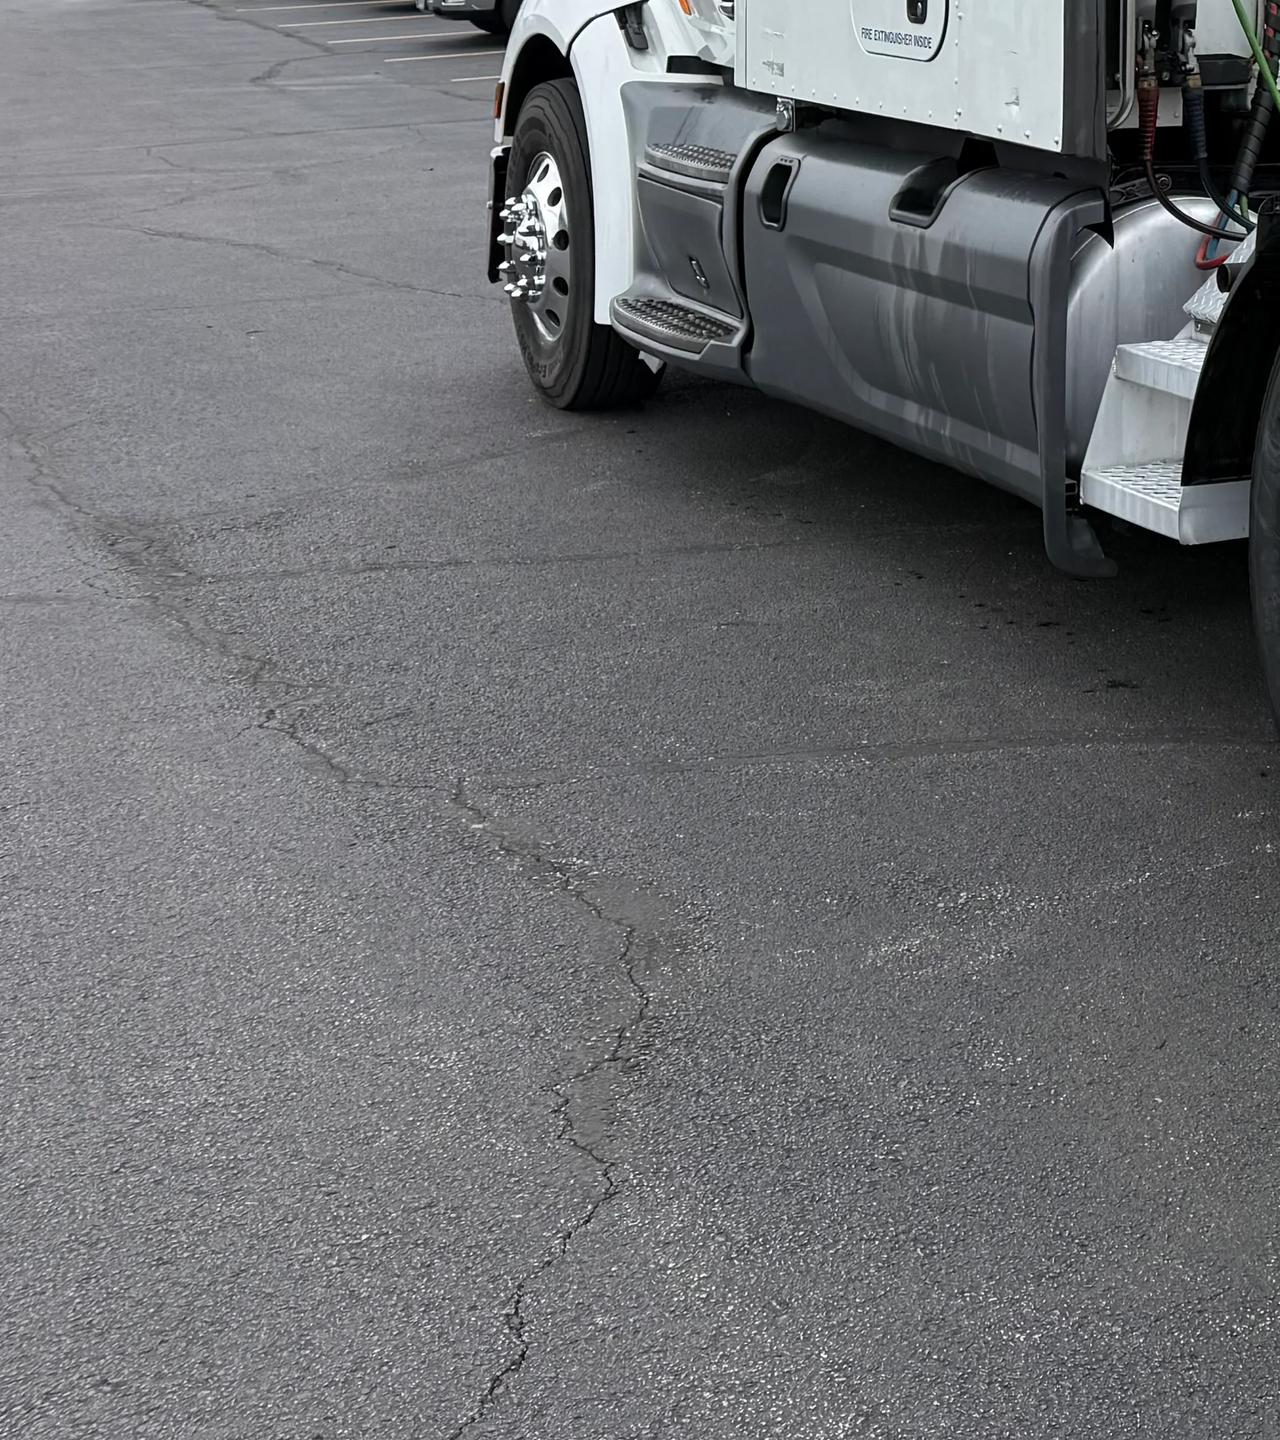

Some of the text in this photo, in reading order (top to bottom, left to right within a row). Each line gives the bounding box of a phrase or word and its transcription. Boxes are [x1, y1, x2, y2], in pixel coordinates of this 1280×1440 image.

[861, 27, 932, 49] FIRE EXTINGUISHER INSIDE
